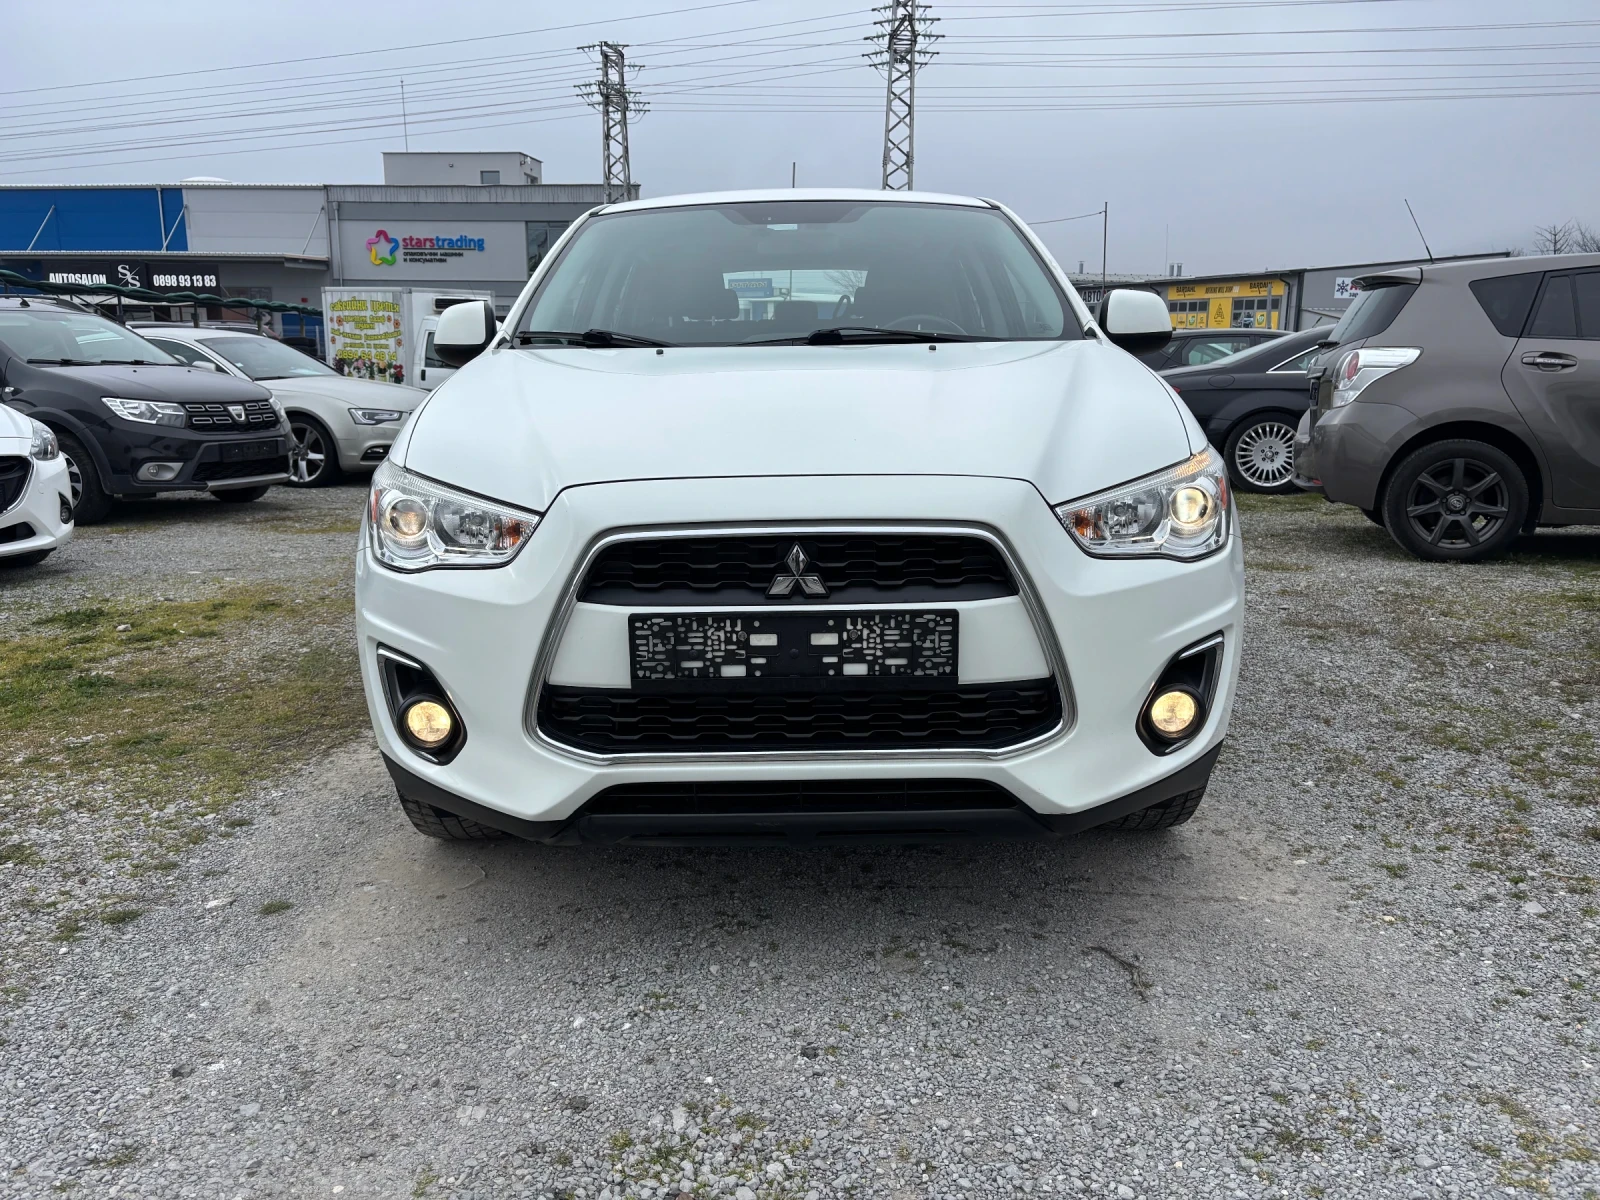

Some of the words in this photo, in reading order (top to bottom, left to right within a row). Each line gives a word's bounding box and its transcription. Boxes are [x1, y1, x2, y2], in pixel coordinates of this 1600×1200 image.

[401, 235, 485, 252] starstrading
[49, 272, 107, 285] AUTOSALON
[153, 274, 178, 287] 0898
[178, 274, 191, 287] 93
[191, 274, 203, 287] 13
[203, 274, 217, 287] 83
